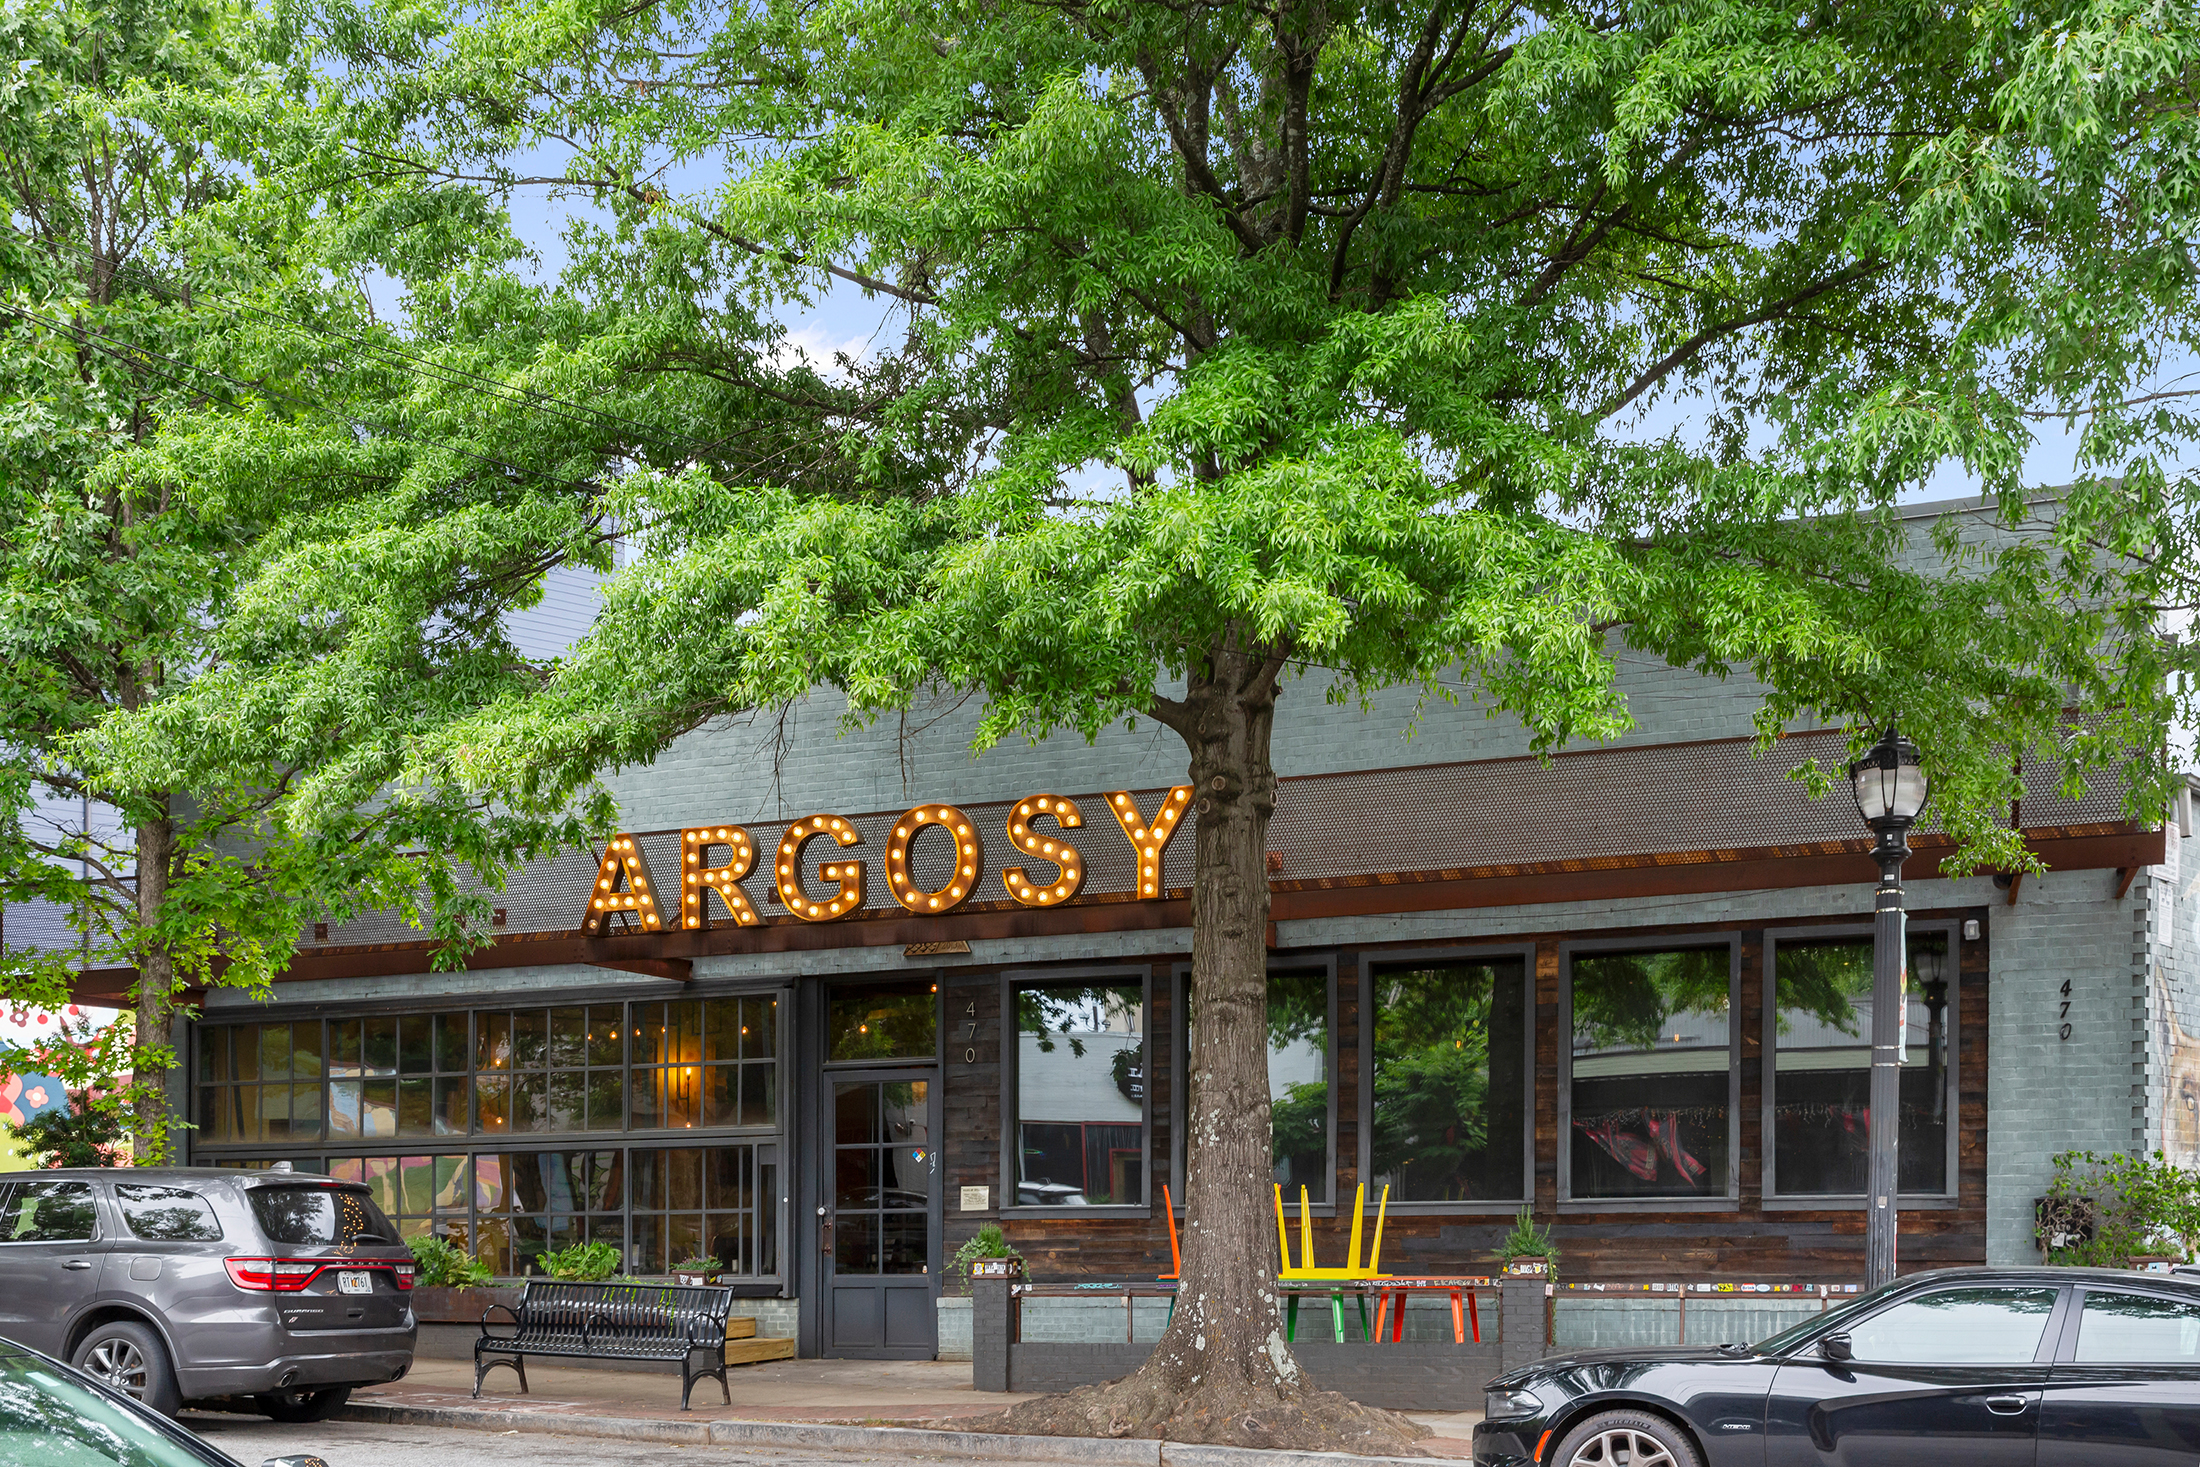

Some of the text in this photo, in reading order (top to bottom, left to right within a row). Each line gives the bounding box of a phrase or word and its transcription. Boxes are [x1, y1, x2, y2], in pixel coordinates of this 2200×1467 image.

[581, 785, 1195, 936] ARGOSY
[965, 1001, 977, 1064] 470
[2059, 979, 2072, 1041] 470
[1607, 1419, 1652, 1430] MICHELIN
